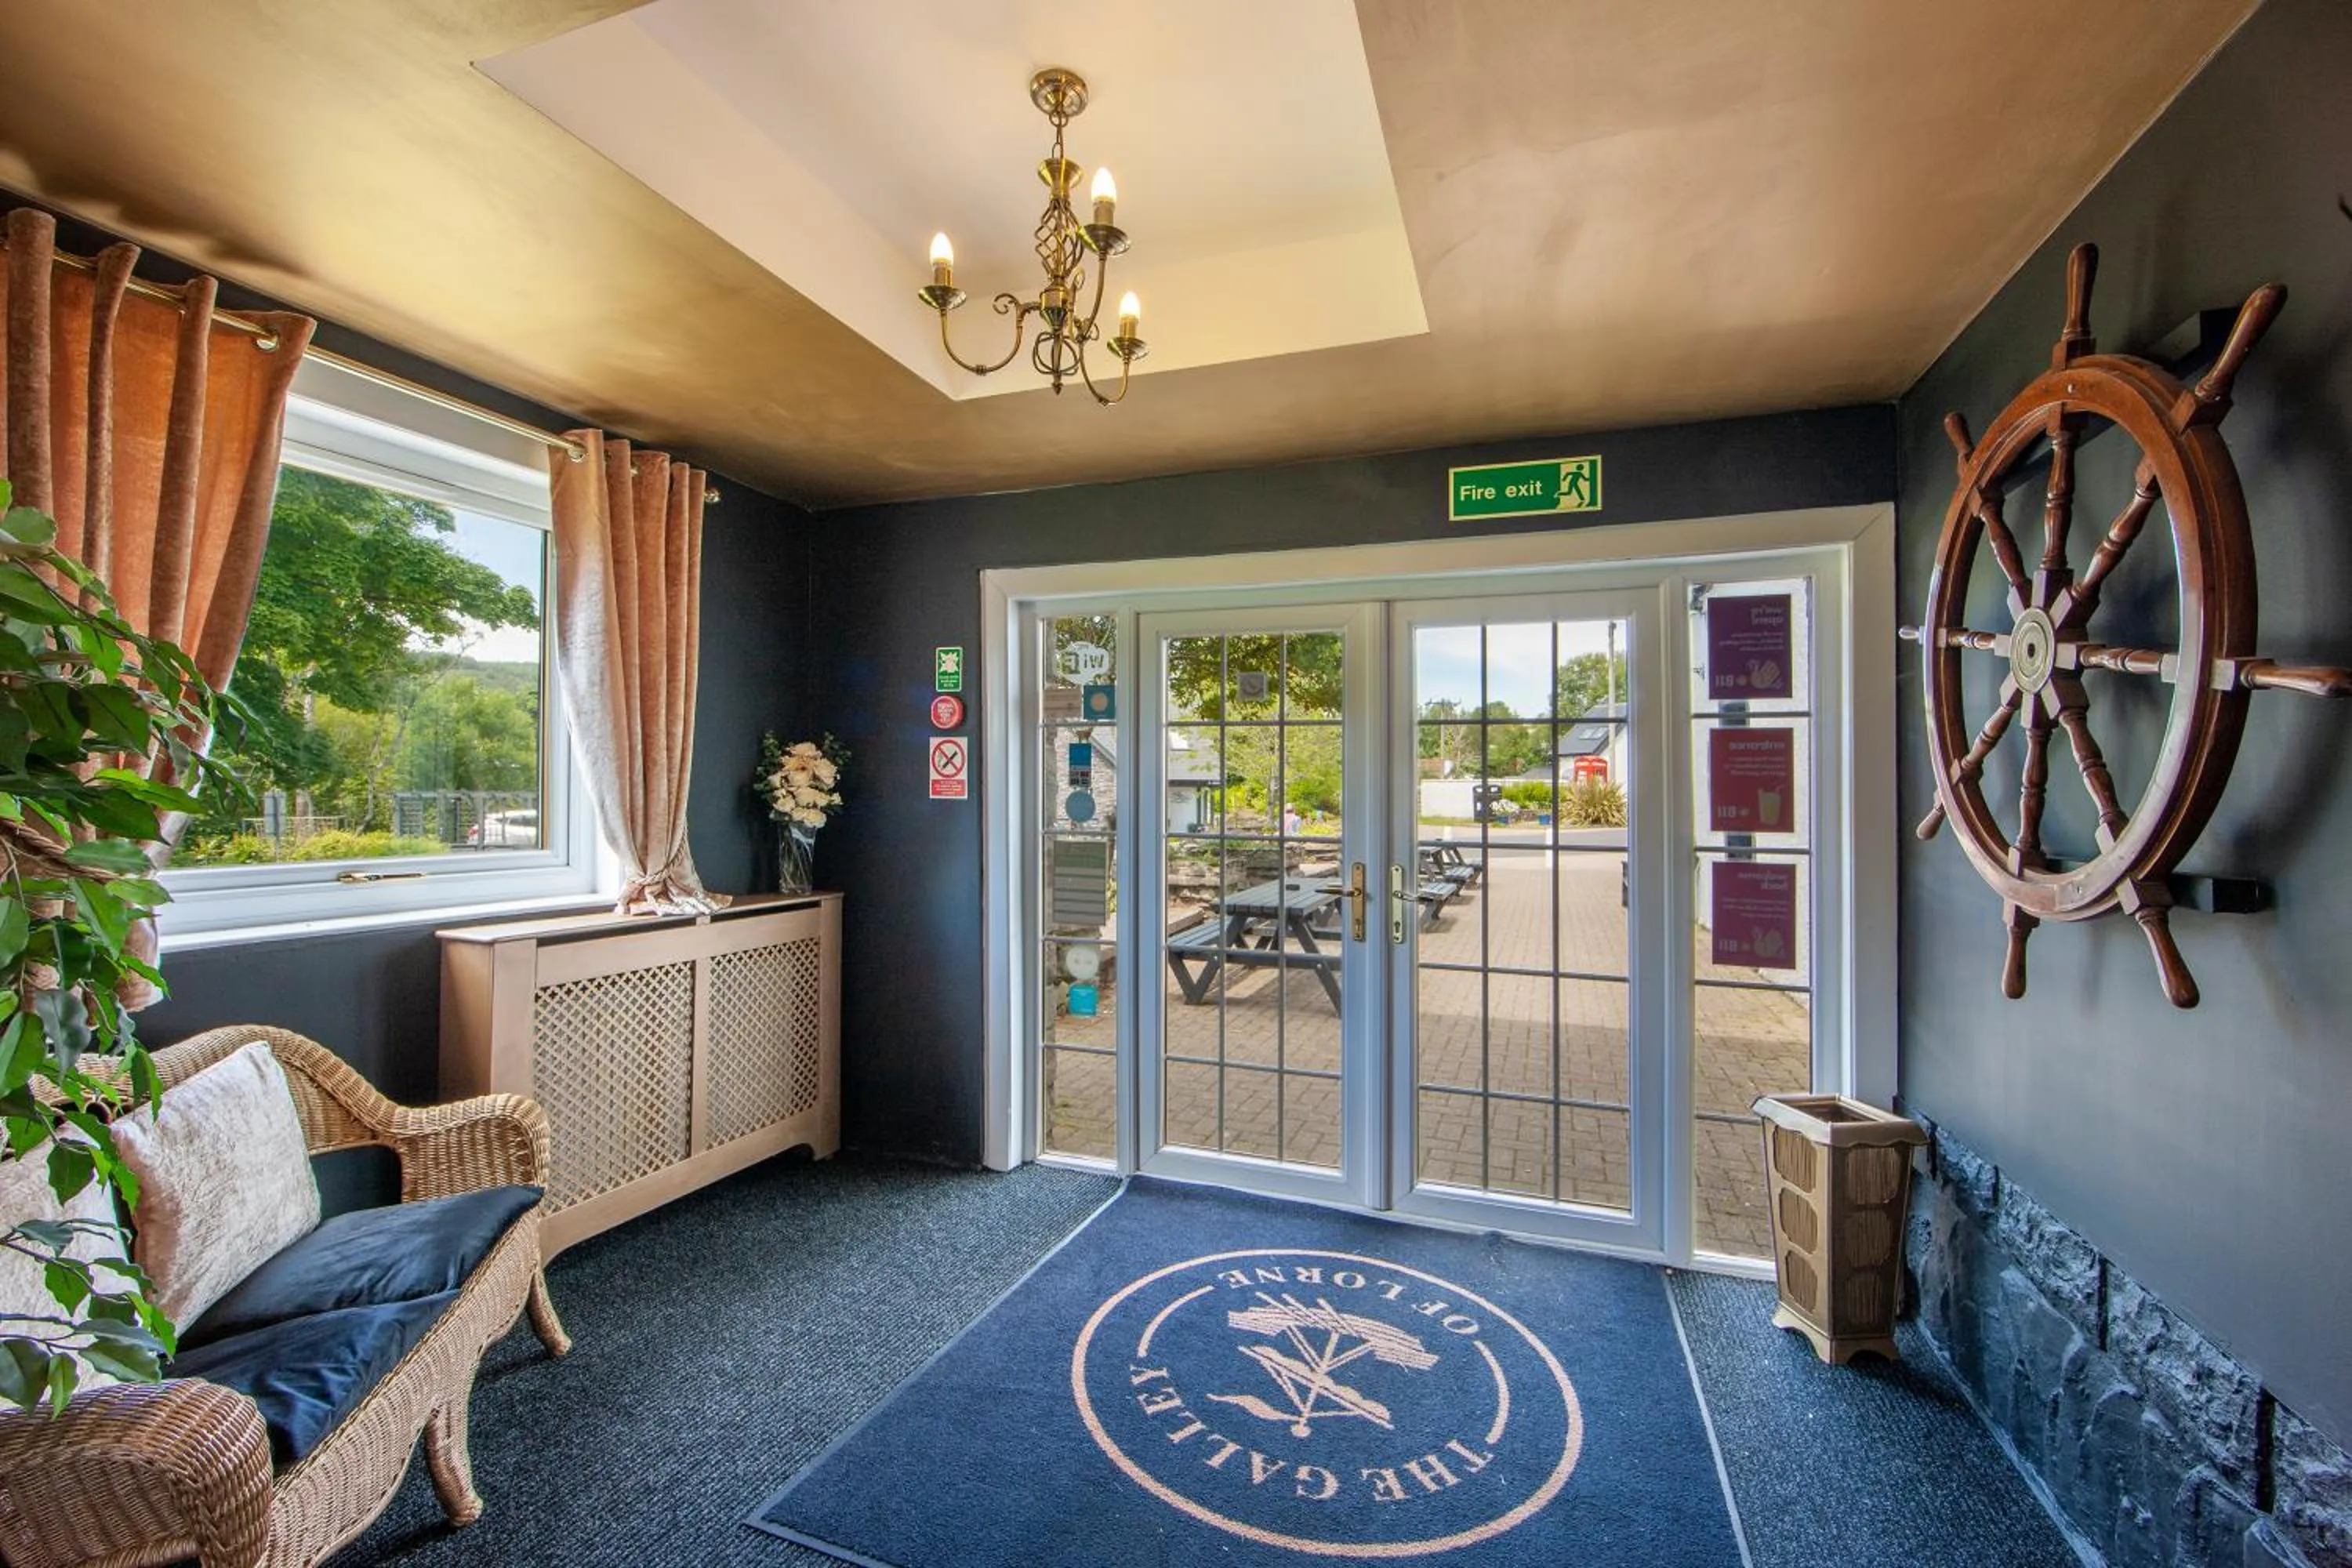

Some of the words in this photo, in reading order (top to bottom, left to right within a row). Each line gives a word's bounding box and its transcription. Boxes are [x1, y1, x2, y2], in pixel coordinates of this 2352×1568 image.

[1460, 485, 1497, 501] Fire
[1505, 481, 1543, 498] exit
[1216, 1266, 1410, 1301] LORNE
[1414, 1301, 1479, 1335] OF
[1130, 1365, 1341, 1501] GALLEY
[1359, 1439, 1494, 1502] THE
